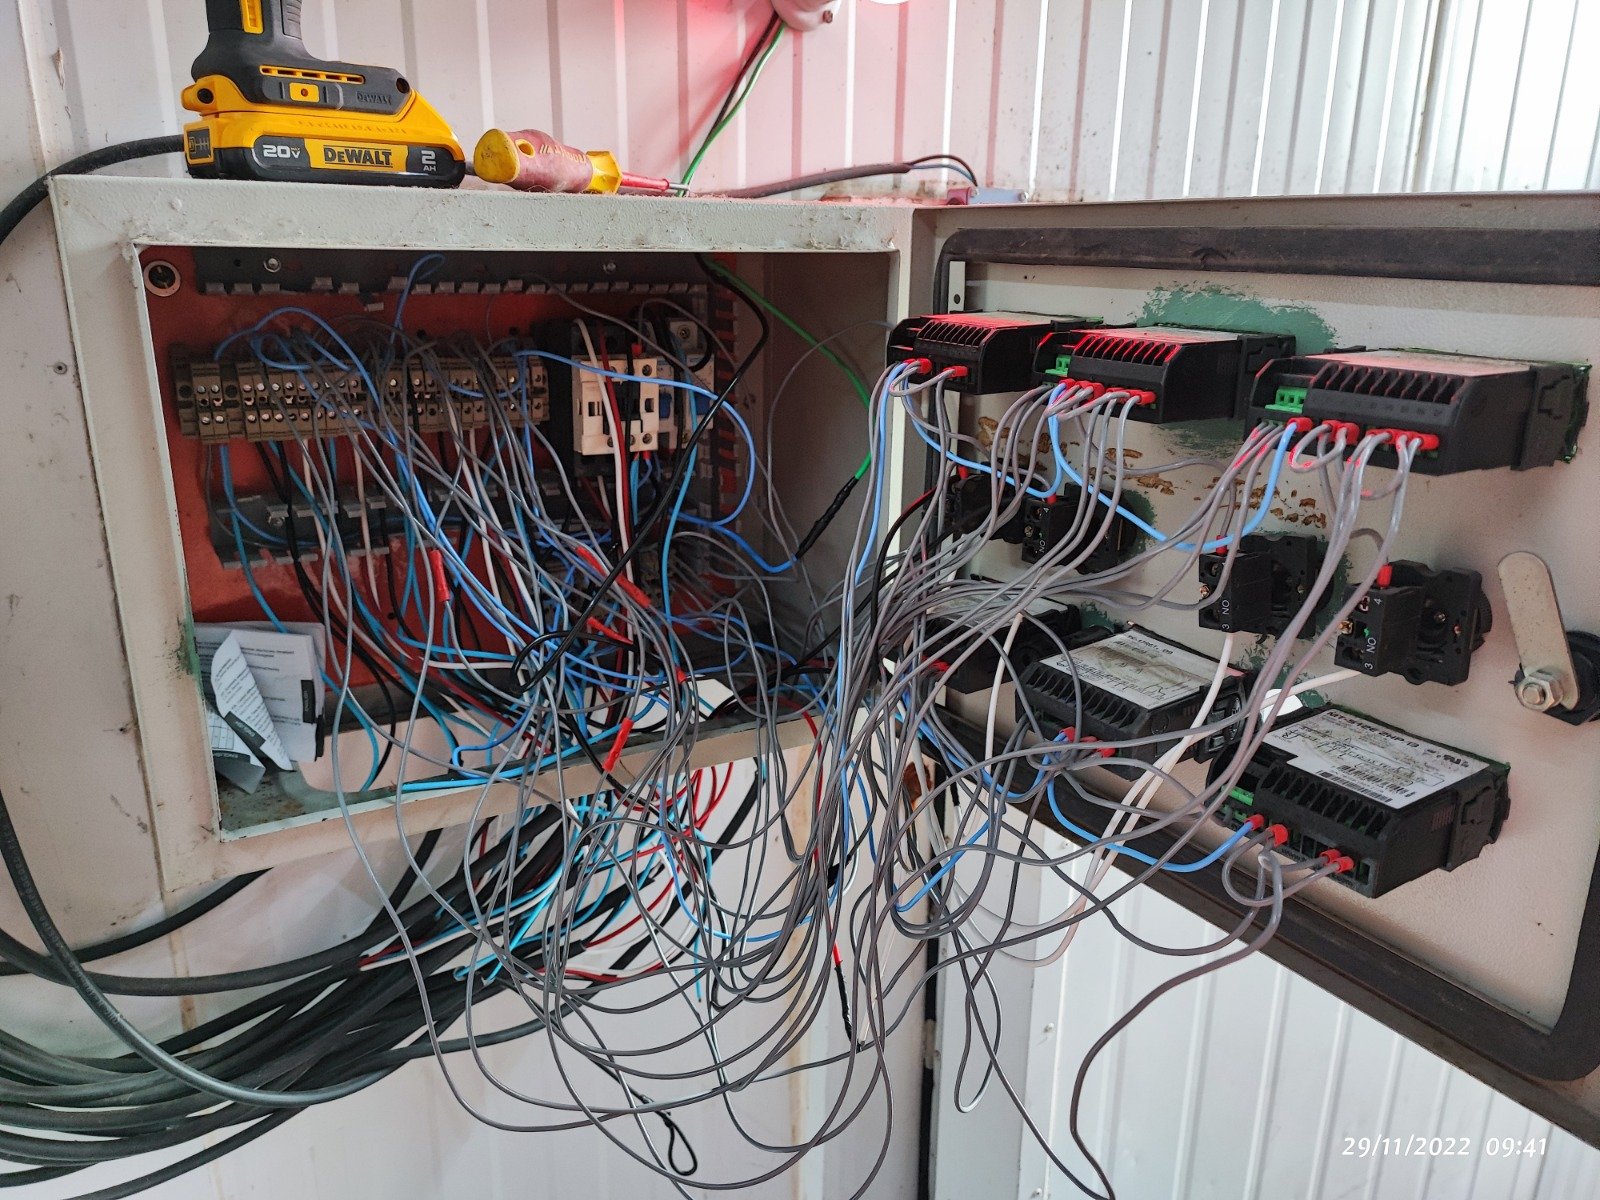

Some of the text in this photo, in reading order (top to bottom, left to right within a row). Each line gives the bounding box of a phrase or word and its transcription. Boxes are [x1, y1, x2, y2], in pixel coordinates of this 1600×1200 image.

[421, 150, 436, 165] 2
[1221, 599, 1230, 615] NO
[1365, 637, 1377, 653] NO
[1364, 662, 1374, 670] 3
